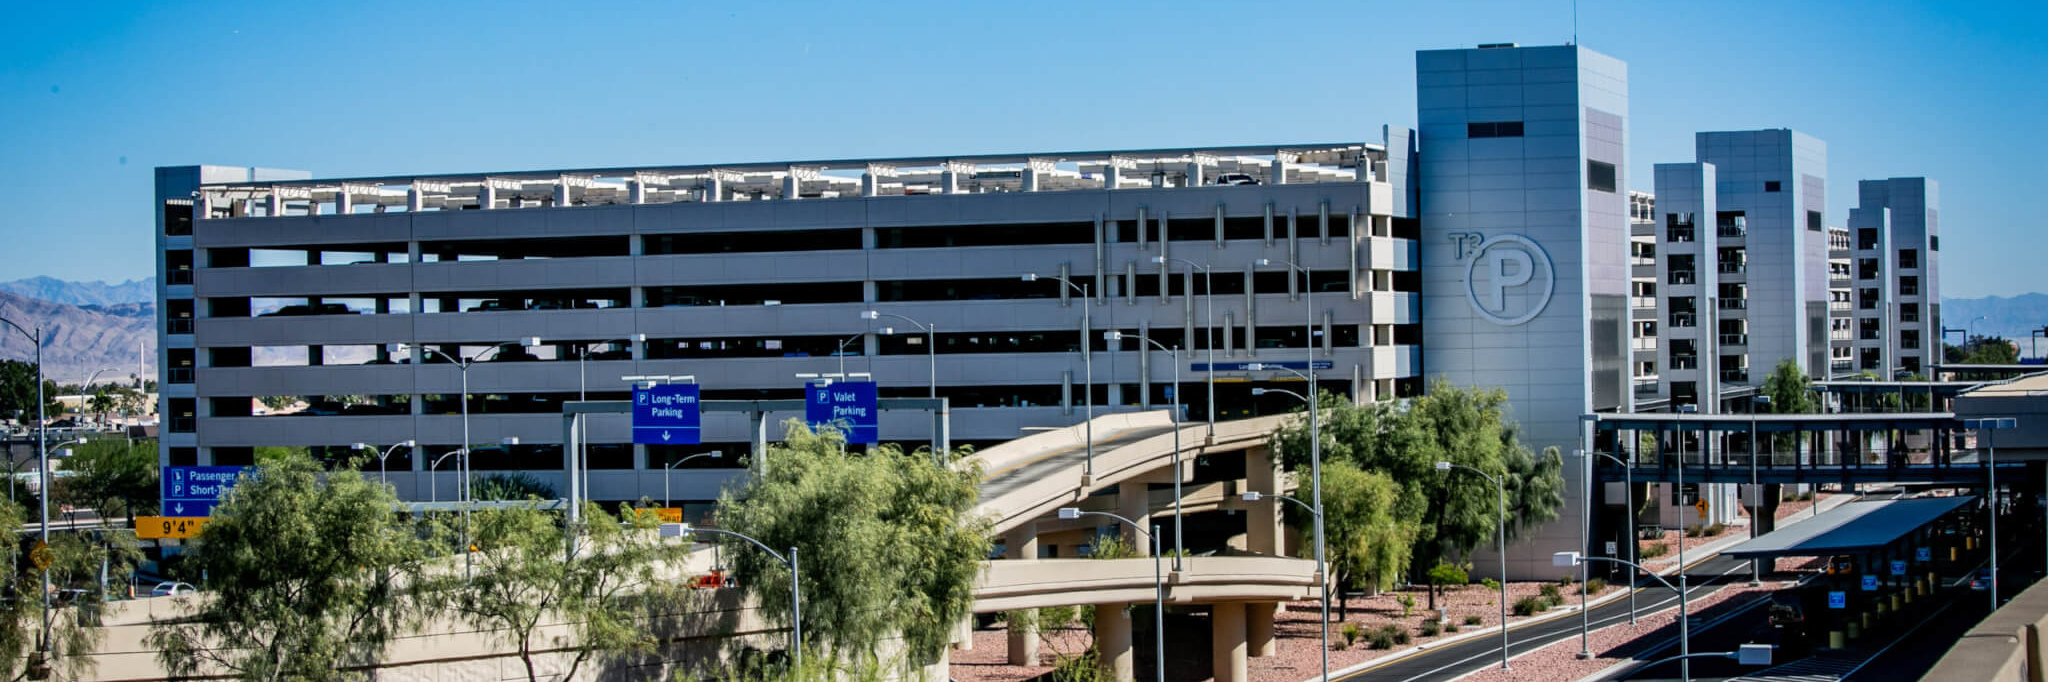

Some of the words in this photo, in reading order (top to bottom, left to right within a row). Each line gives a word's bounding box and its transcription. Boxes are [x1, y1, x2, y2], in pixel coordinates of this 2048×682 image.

[1448, 231, 1484, 260] T3
[1489, 248, 1535, 312] P
[640, 394, 646, 403] P
[651, 394, 695, 405] Long-Term
[820, 392, 826, 402] P
[833, 392, 856, 402] Valet
[651, 407, 683, 419] Parking
[833, 405, 867, 417] Parking
[190, 470, 235, 483] Passenger
[174, 485, 181, 494] P
[163, 521, 194, 535] 9'4"
